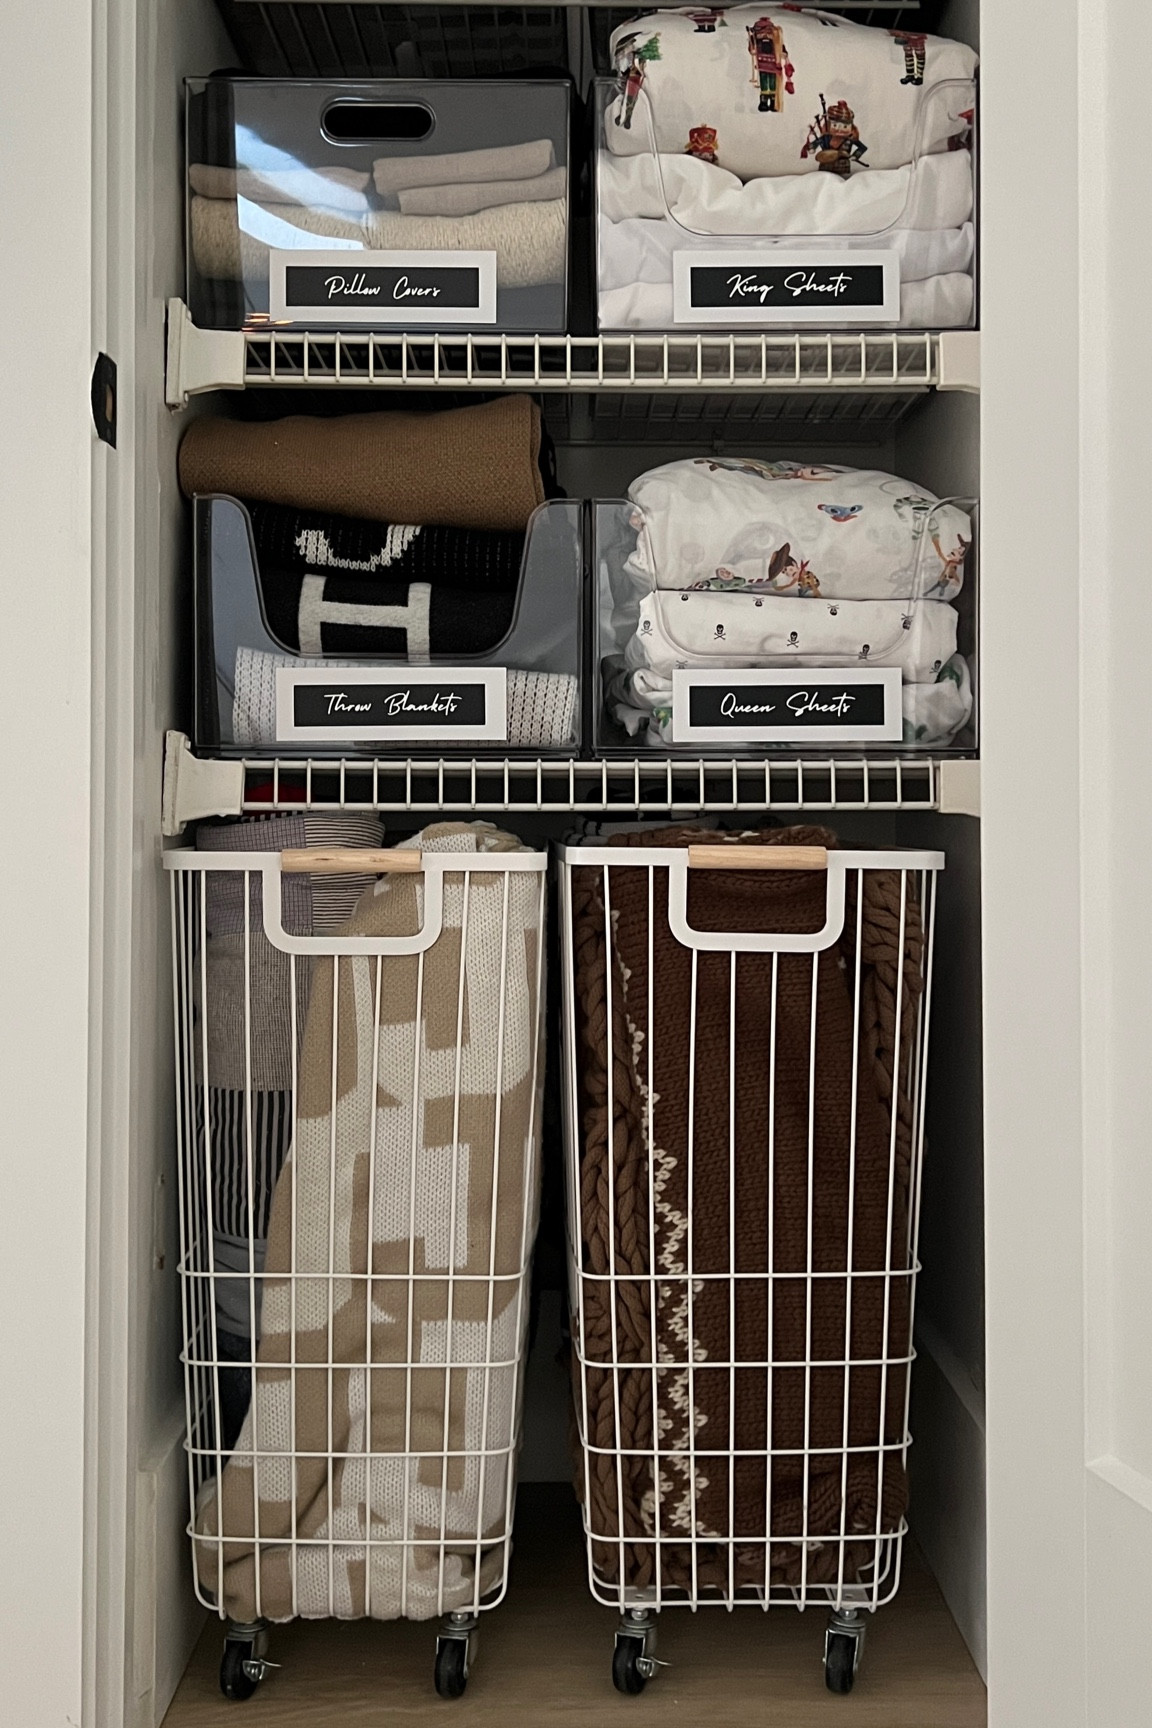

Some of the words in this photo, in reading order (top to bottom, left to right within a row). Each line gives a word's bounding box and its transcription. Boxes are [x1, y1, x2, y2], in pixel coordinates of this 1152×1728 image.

[325, 273, 380, 299] Pillow
[393, 276, 440, 299] Covers
[727, 274, 773, 302] King
[784, 272, 852, 296] Sheets
[324, 693, 371, 714] Throw
[384, 690, 462, 715] Blankets
[721, 693, 775, 718] Queen
[786, 692, 855, 716] Sheets
